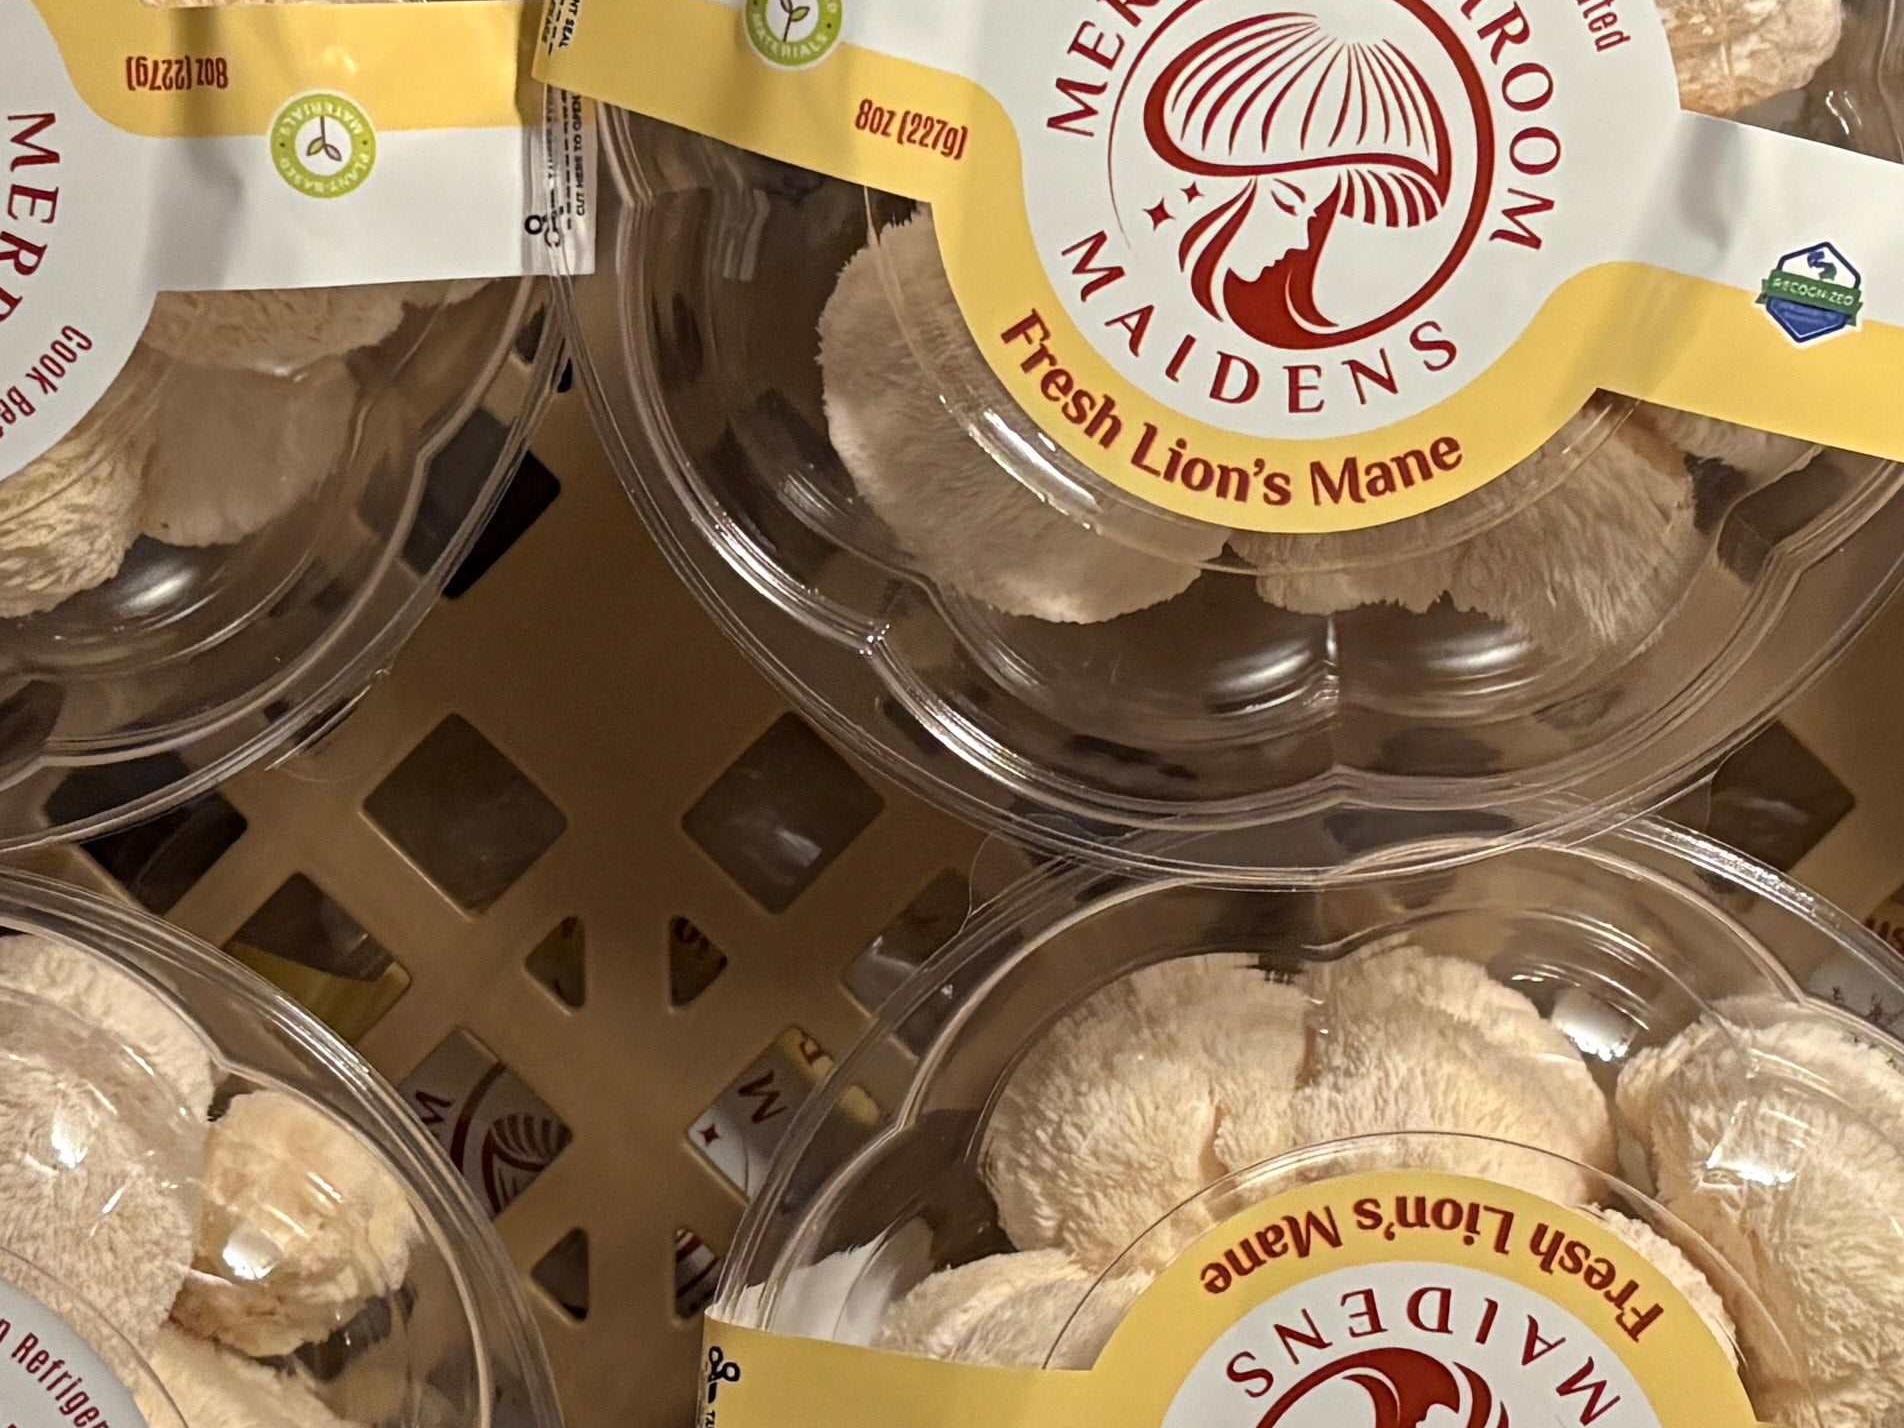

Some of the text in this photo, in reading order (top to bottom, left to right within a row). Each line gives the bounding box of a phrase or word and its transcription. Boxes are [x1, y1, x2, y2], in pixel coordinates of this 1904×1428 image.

[125, 55, 229, 92] 8oz (227g)
[855, 98, 968, 160] 8oz (227g)
[26, 326, 93, 392] Cook
[1067, 232, 1457, 413] MAIDENS
[1002, 309, 1462, 506] Fresh Lion's Mane
[1198, 1196, 1662, 1341] Fresh Lion's Mane
[1226, 1288, 1616, 1425] MAIDENS
